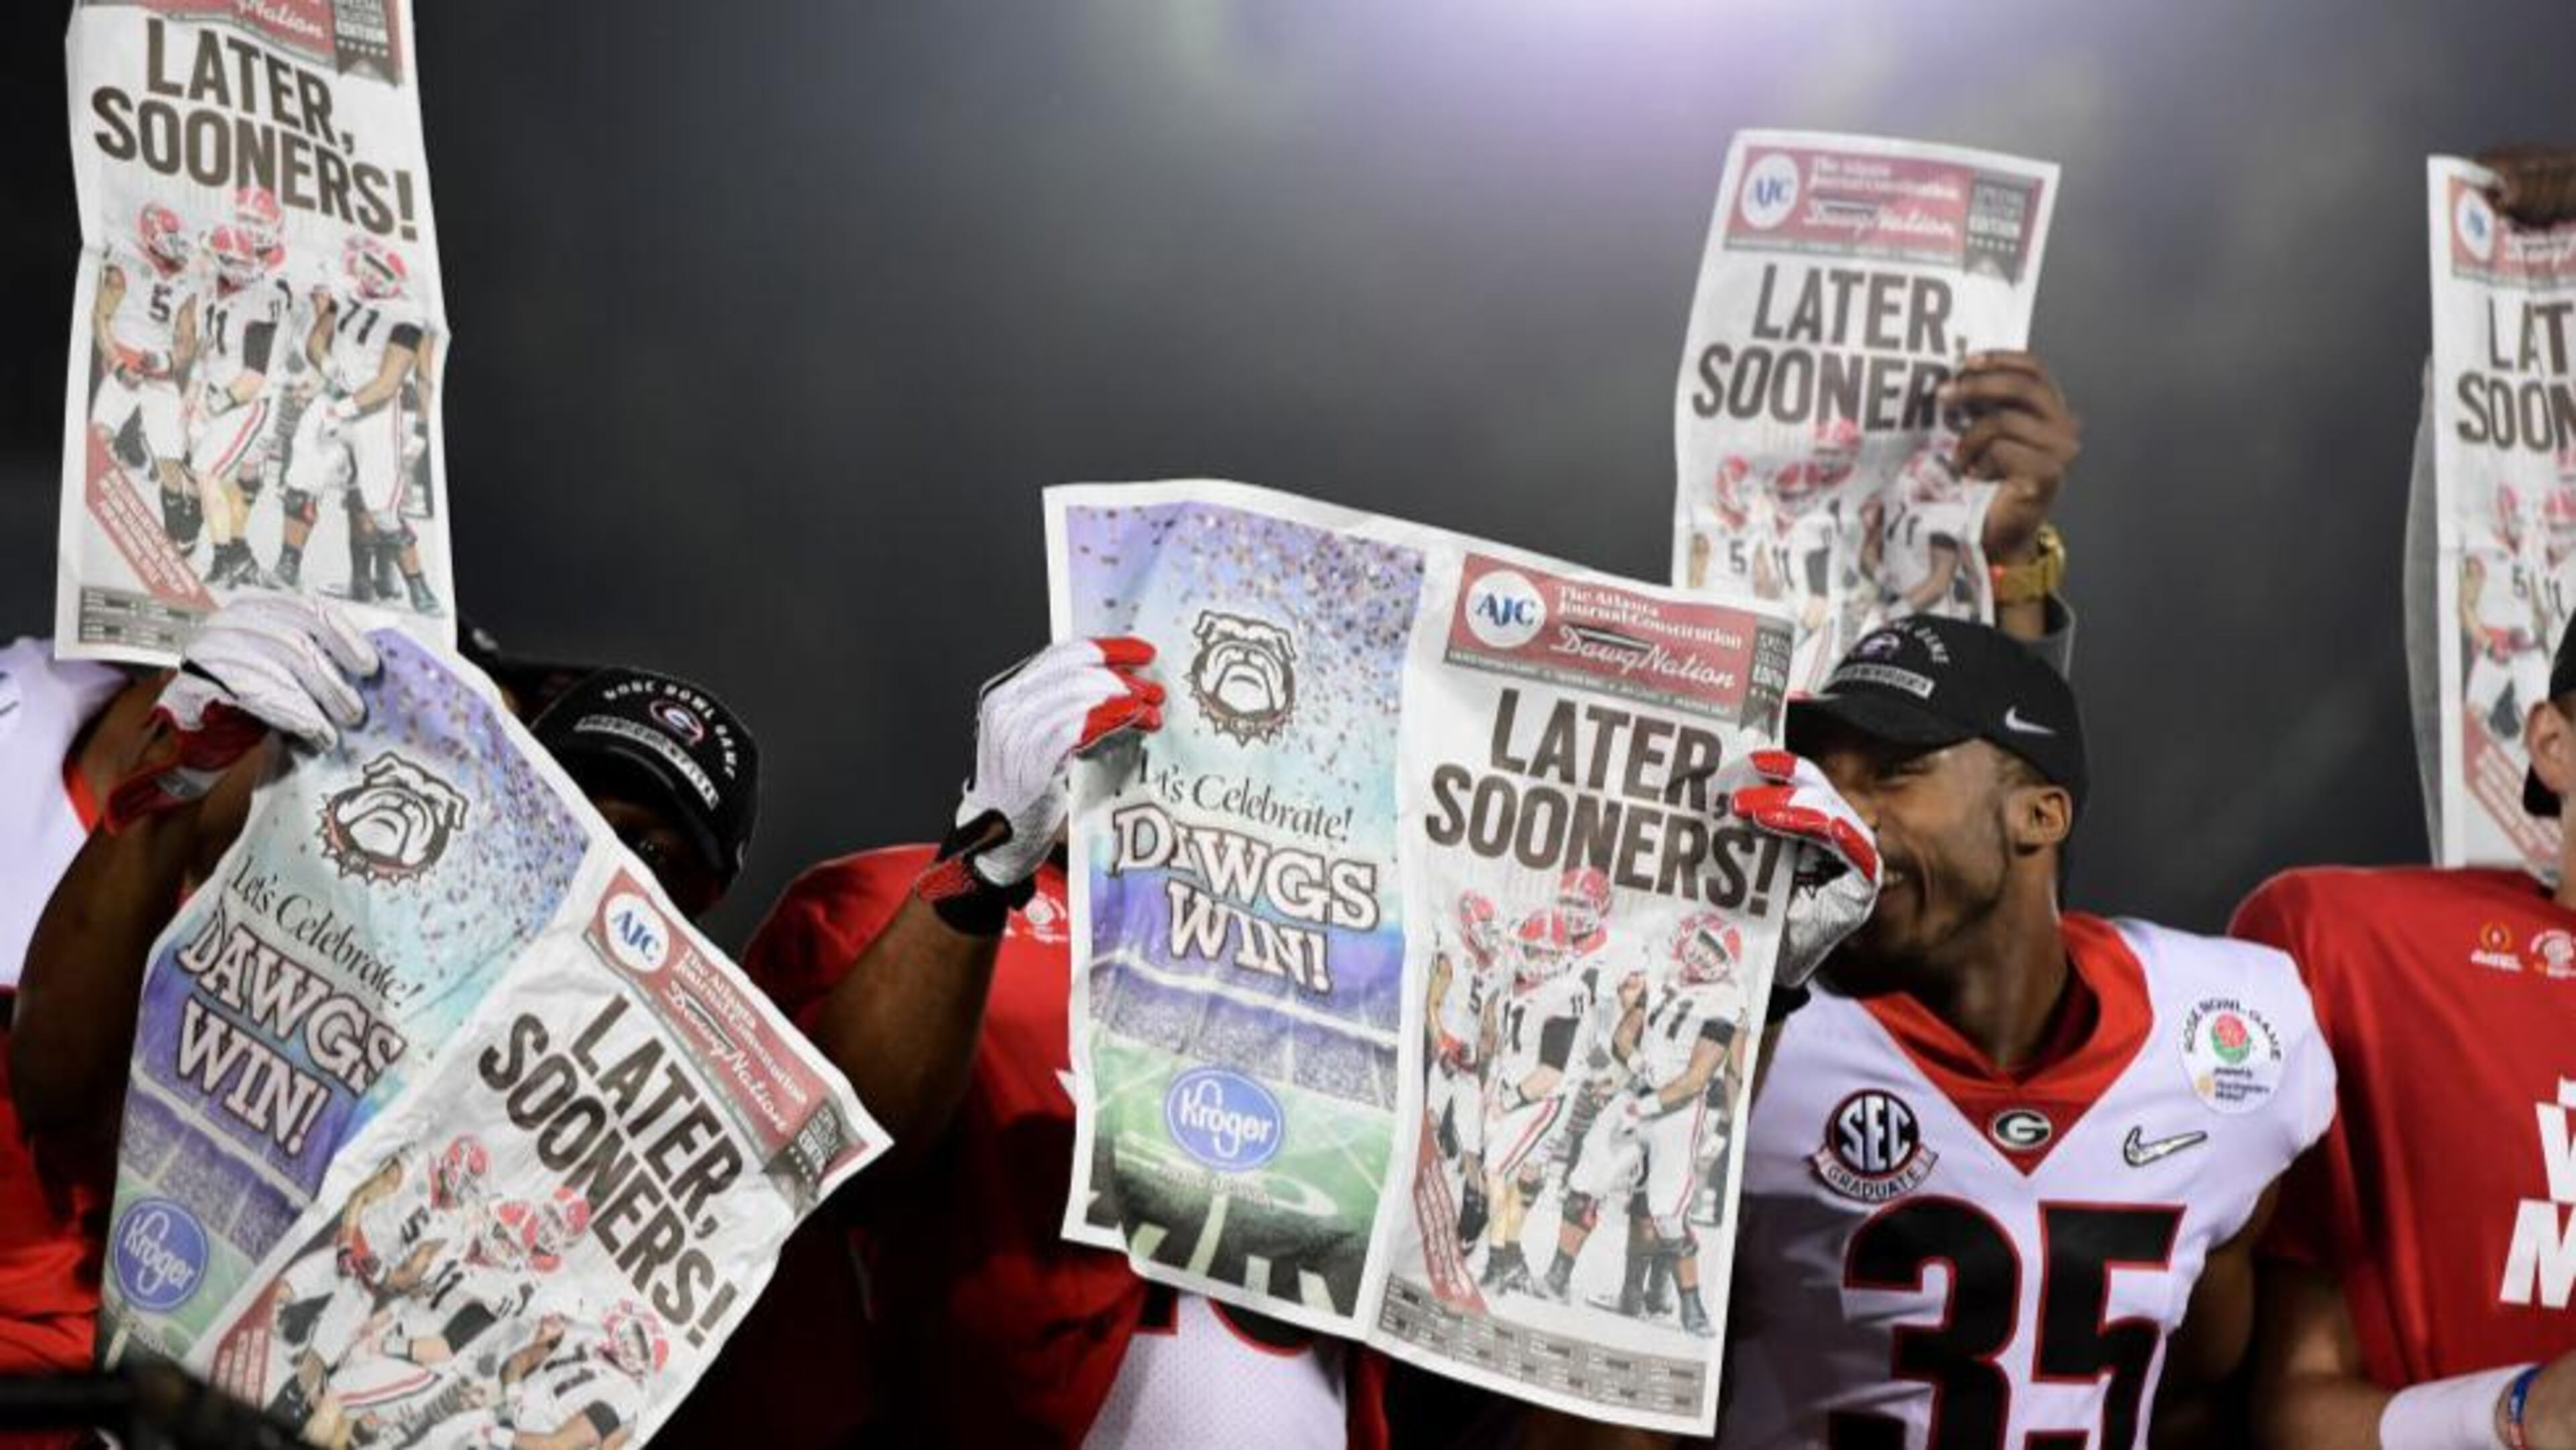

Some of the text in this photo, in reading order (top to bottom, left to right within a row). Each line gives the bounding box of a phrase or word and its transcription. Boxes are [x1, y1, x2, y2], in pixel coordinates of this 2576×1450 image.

[145, 17, 354, 154] LATER,
[91, 87, 418, 242] SOONERS!
[150, 284, 172, 323] 5
[337, 299, 380, 345] 71
[1752, 264, 1968, 365] LATER,
[1692, 344, 1970, 433] SOONER
[1556, 584, 1592, 605] The
[1729, 540, 1747, 575] 5
[1476, 592, 1536, 627] AJC
[1491, 688, 1731, 820] LATER,
[1192, 772, 1353, 842] Celebrate!
[1425, 763, 1782, 917] SOONERS!
[231, 856, 426, 1008] Let's Celebrate!
[612, 910, 661, 962] AJC
[1167, 879, 1333, 996] WIN!
[176, 896, 407, 1100] DAWGS
[176, 996, 333, 1159] WIN!
[570, 993, 743, 1240] LATER,
[1179, 1077, 1274, 1159] Kroger
[478, 1012, 740, 1349] SOONERS!
[1827, 1163, 1923, 1198] GRADUATE
[1838, 1095, 1911, 1171] SEC
[123, 1210, 195, 1296] Kroger
[1828, 1195, 2188, 1450] 35
